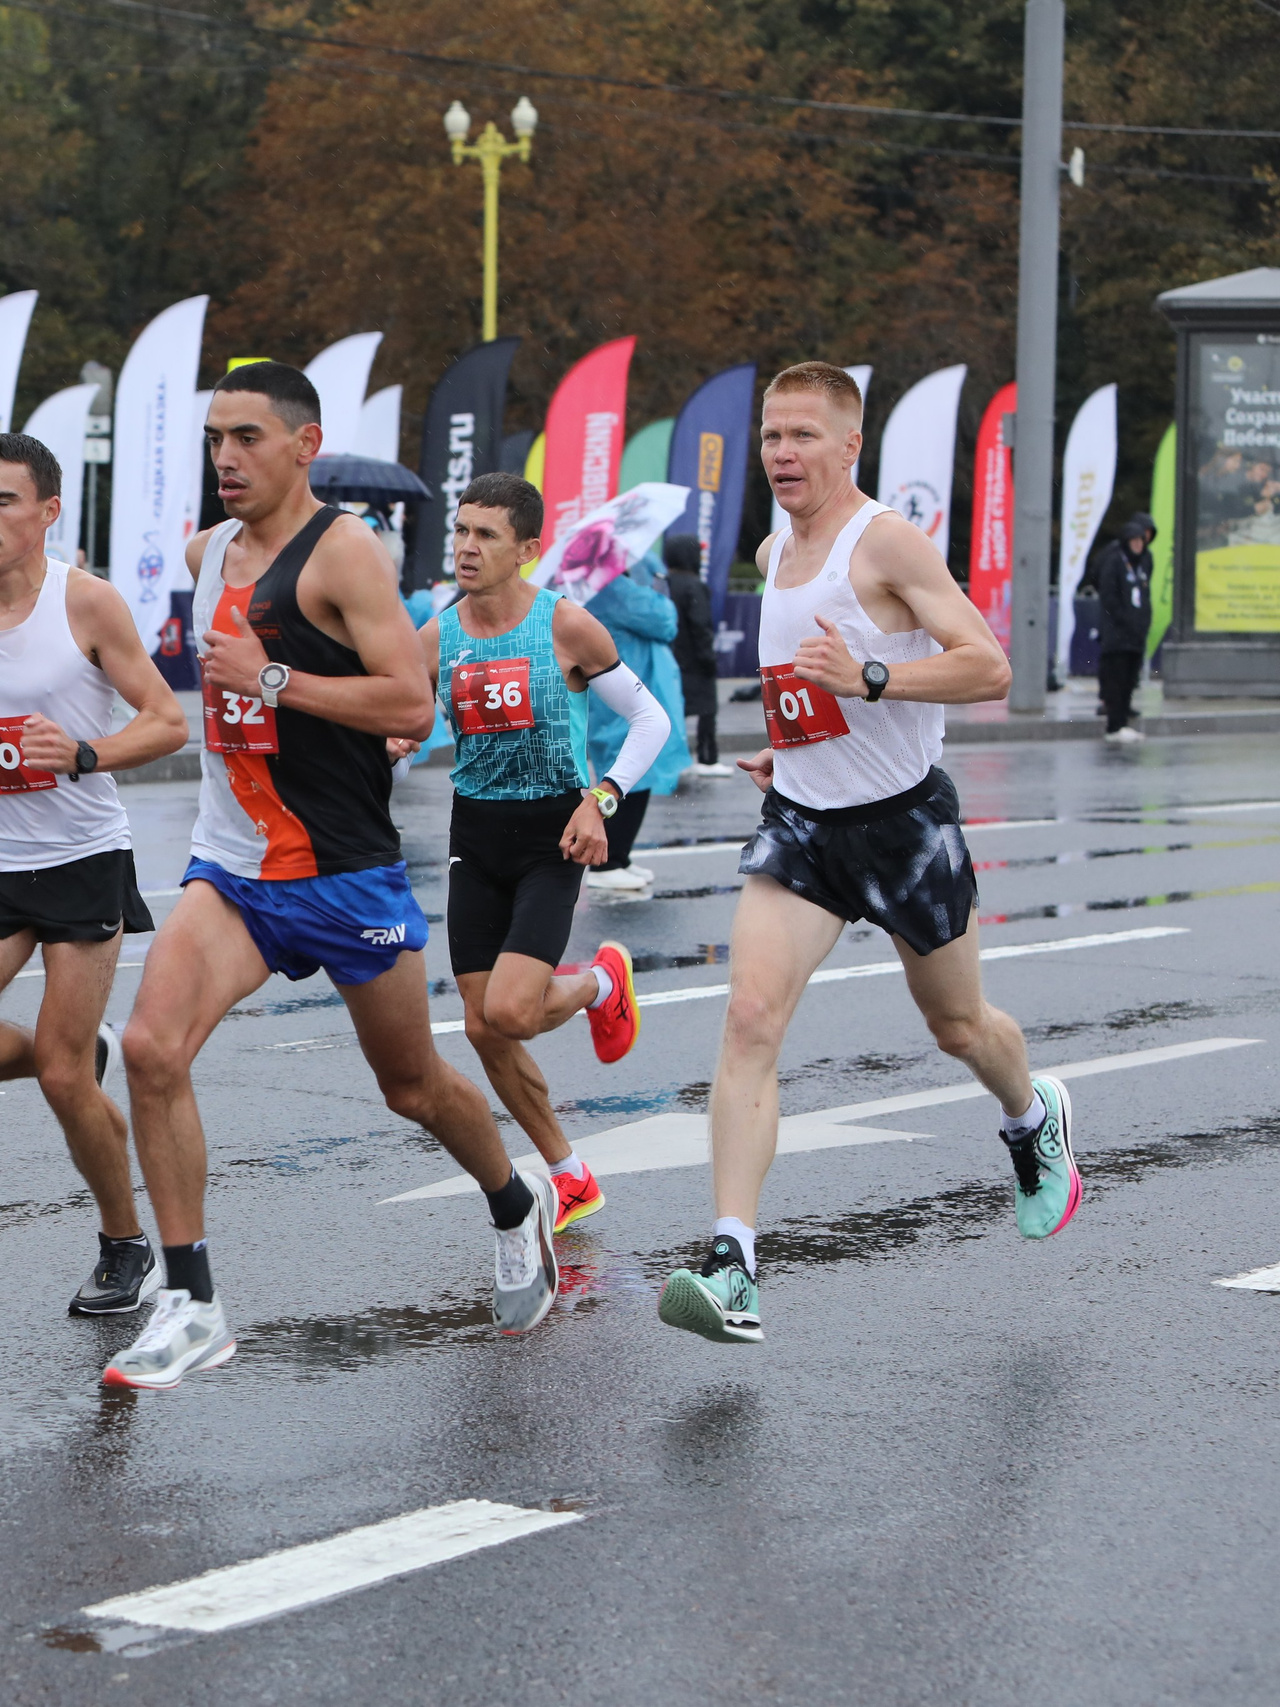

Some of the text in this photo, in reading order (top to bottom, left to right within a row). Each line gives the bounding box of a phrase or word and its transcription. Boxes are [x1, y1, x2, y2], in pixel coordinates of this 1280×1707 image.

[222, 691, 265, 725] 32
[484, 681, 522, 710] 36
[780, 688, 815, 720] 01
